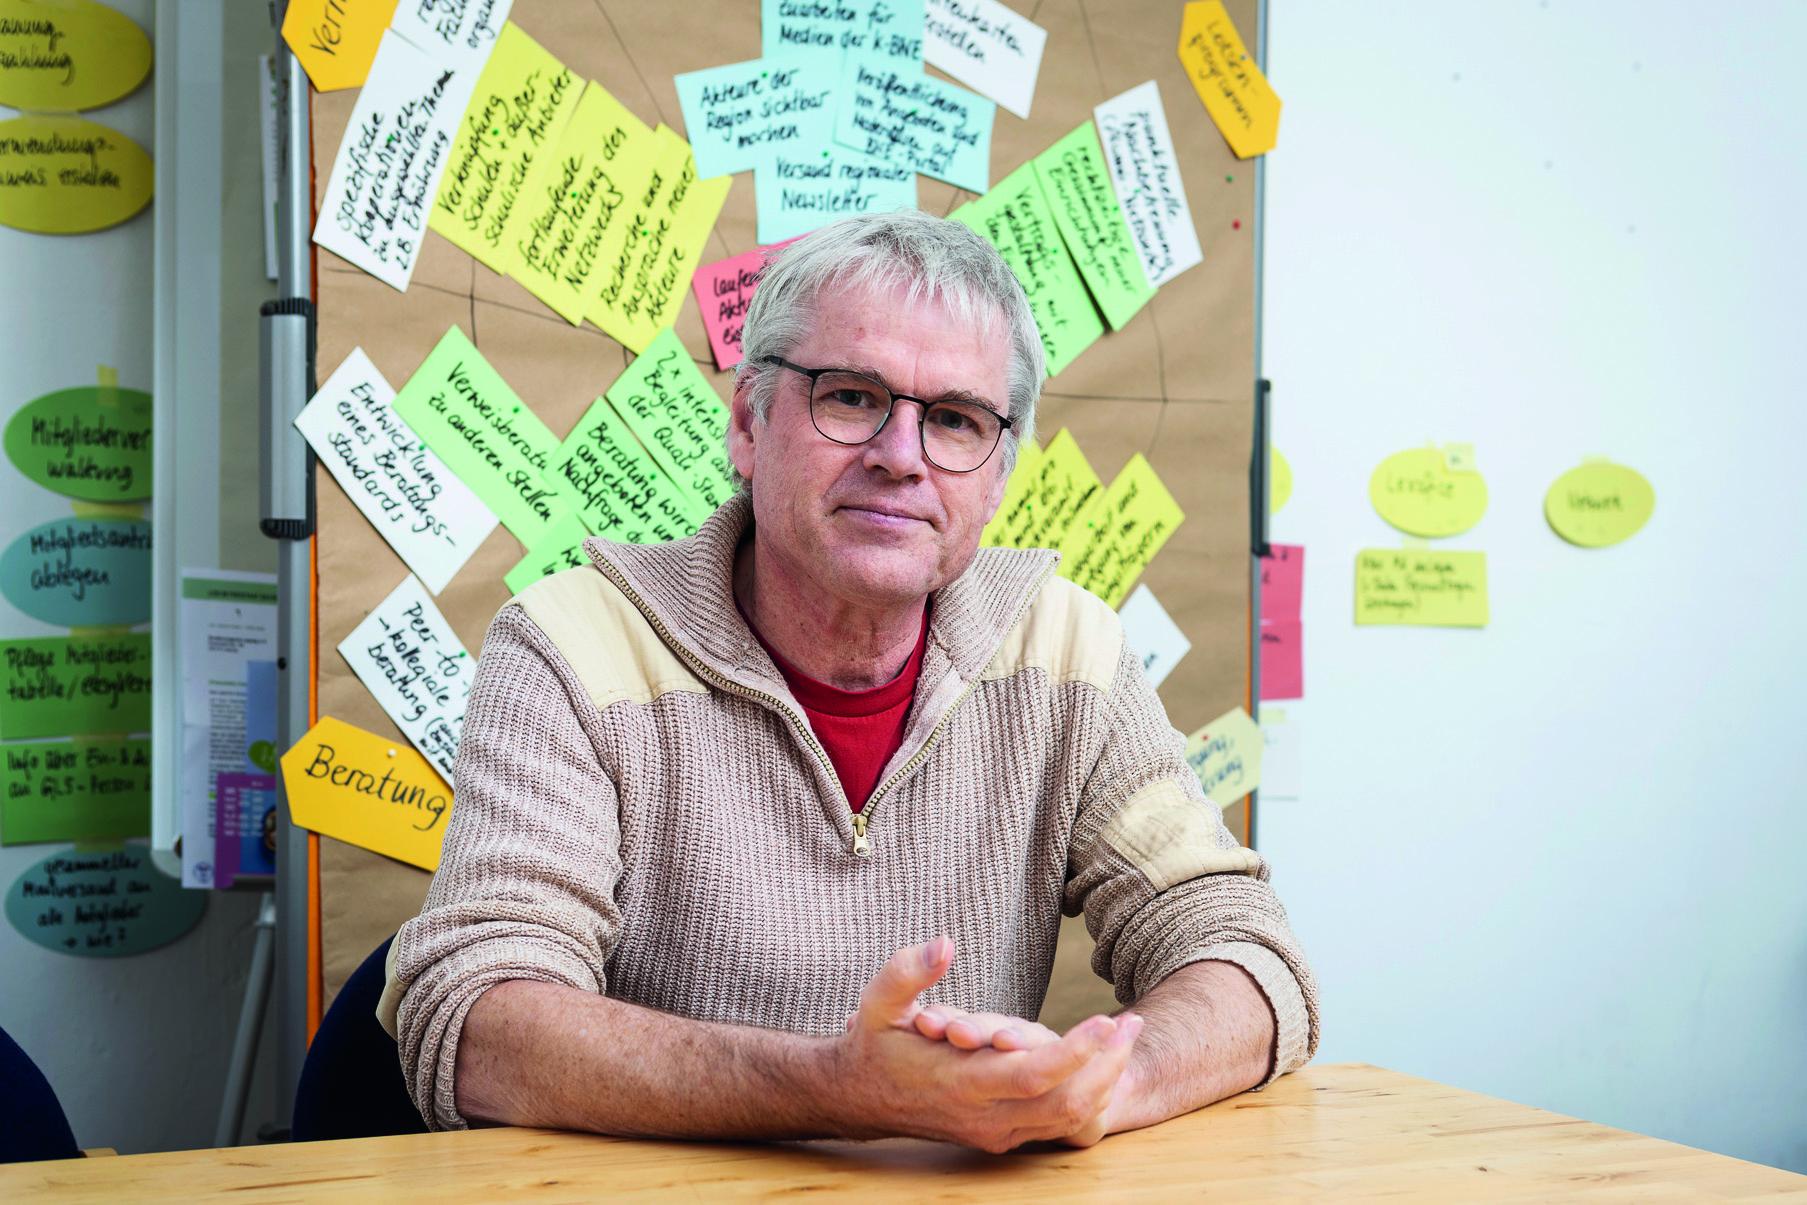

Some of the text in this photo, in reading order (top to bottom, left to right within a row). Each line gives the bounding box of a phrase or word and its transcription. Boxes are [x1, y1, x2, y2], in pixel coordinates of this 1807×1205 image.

[779, 24, 834, 46] Medien
[840, 31, 867, 49] der
[526, 67, 571, 147] Anbieter
[700, 68, 800, 110] Akteure der
[706, 107, 753, 142] Region
[438, 94, 510, 215] Verknüpfung
[738, 124, 800, 148] machen
[776, 156, 834, 179] Versand
[402, 130, 450, 231] Ernährung
[464, 158, 503, 230] Schulen
[518, 152, 584, 273] fortlaufende
[781, 188, 877, 212] Newsletter
[543, 166, 613, 281] Erweiterung
[564, 186, 624, 293] Netzwerks
[601, 170, 663, 310] Recherche und
[623, 153, 695, 325] Ansprache neuer
[646, 247, 686, 328] Akteure
[1049, 299, 1070, 329] mit
[30, 413, 152, 459] Mitgliederver
[350, 381, 442, 503] Entwicklung
[447, 361, 547, 470] Verweisberatu
[628, 395, 655, 419] der
[643, 369, 710, 457] Begleitung
[681, 383, 724, 441] intensi
[337, 401, 456, 546] eines Beratungs-
[428, 392, 558, 523] zu anderen Stellen
[558, 457, 624, 531] Nachfrage
[575, 444, 652, 523] angeboten
[587, 421, 657, 504] Beratung
[30, 525, 152, 566] Mitgliedsantr
[31, 560, 110, 601] ablegen
[402, 601, 438, 643] Peer
[368, 642, 428, 722] beratung
[7, 750, 38, 781] Info
[304, 744, 446, 831] Beratung
